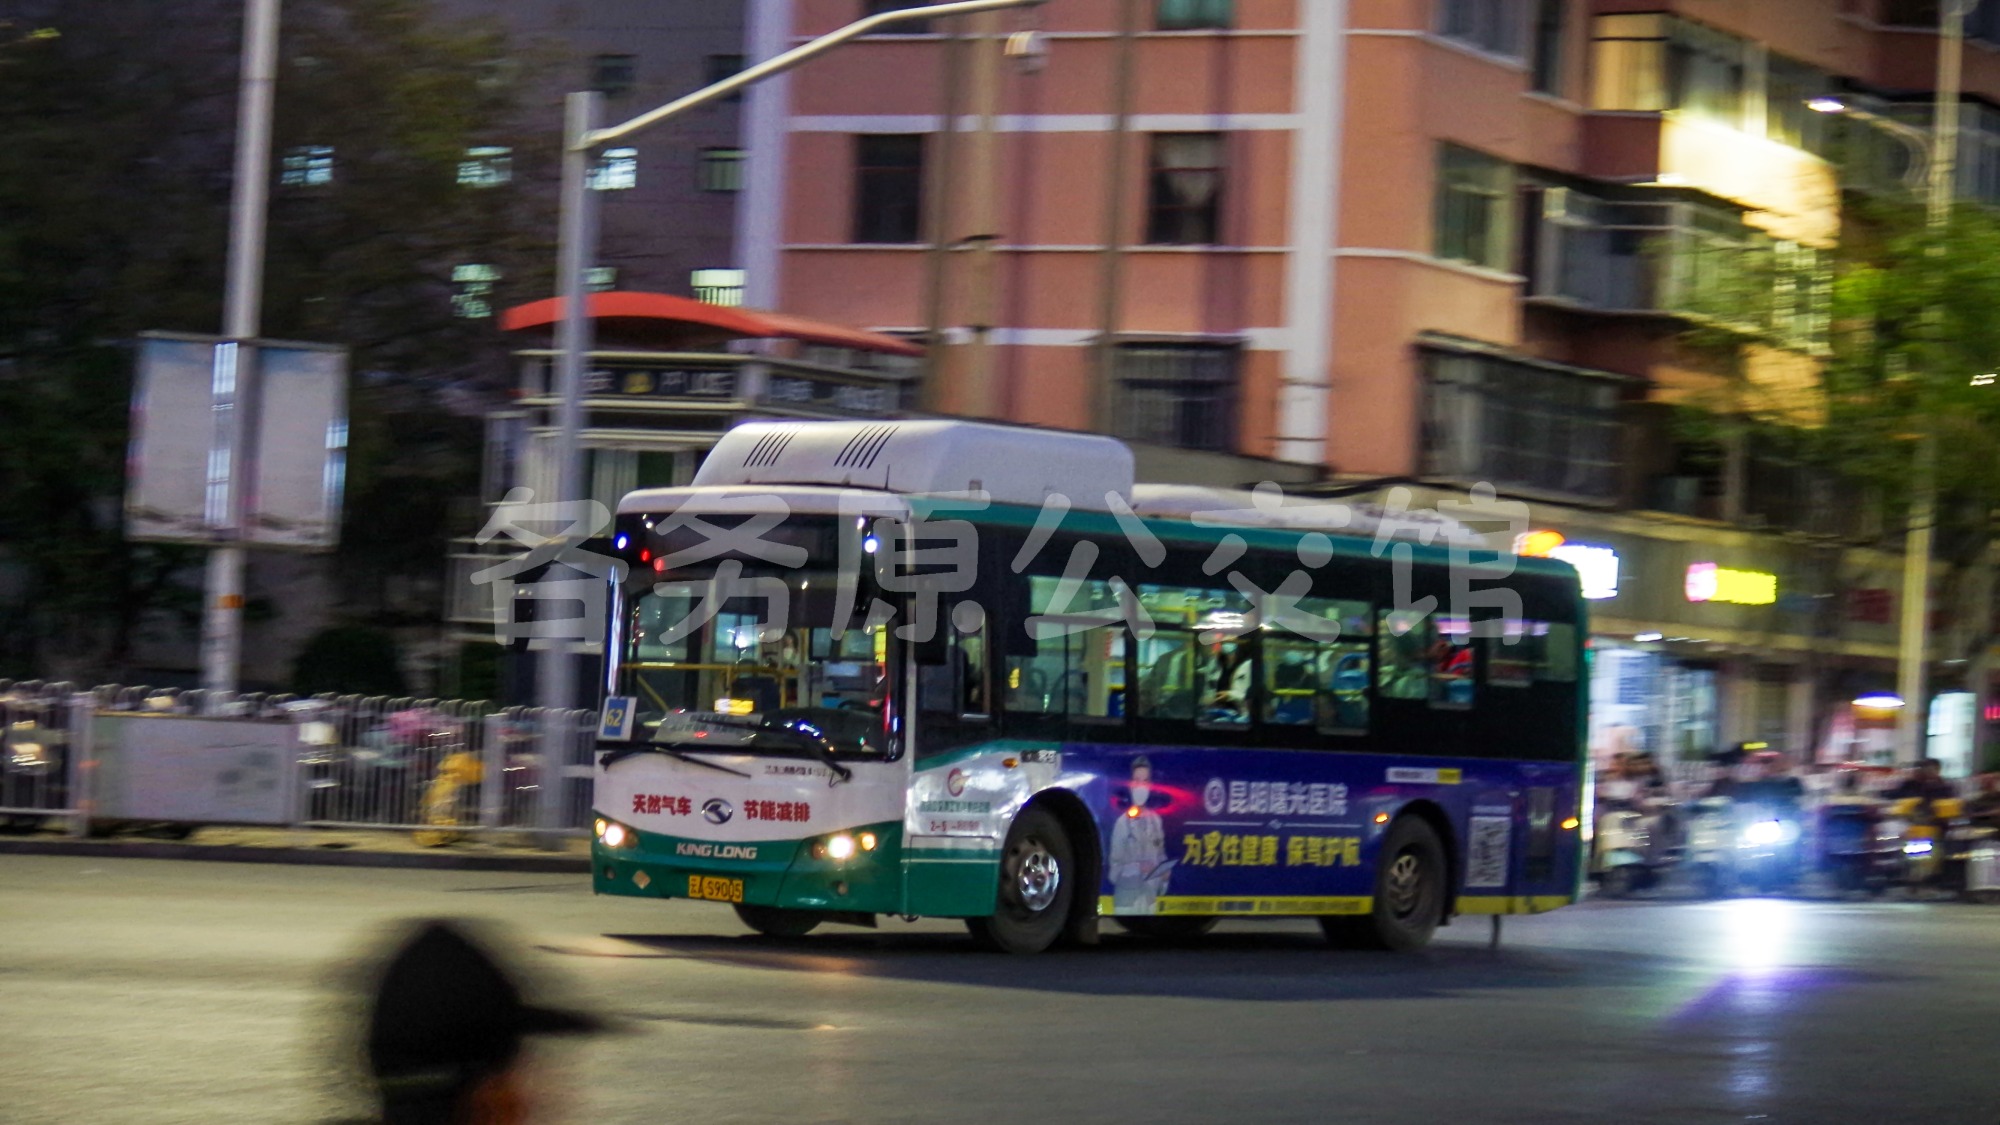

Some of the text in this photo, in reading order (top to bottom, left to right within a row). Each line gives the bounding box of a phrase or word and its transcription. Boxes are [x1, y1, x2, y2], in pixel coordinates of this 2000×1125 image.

[606, 708, 623, 727] 62
[632, 794, 810, 823] 天然气车 节能减排
[1228, 780, 1349, 816] 昆明曙光医院
[676, 842, 758, 860] KING LONG
